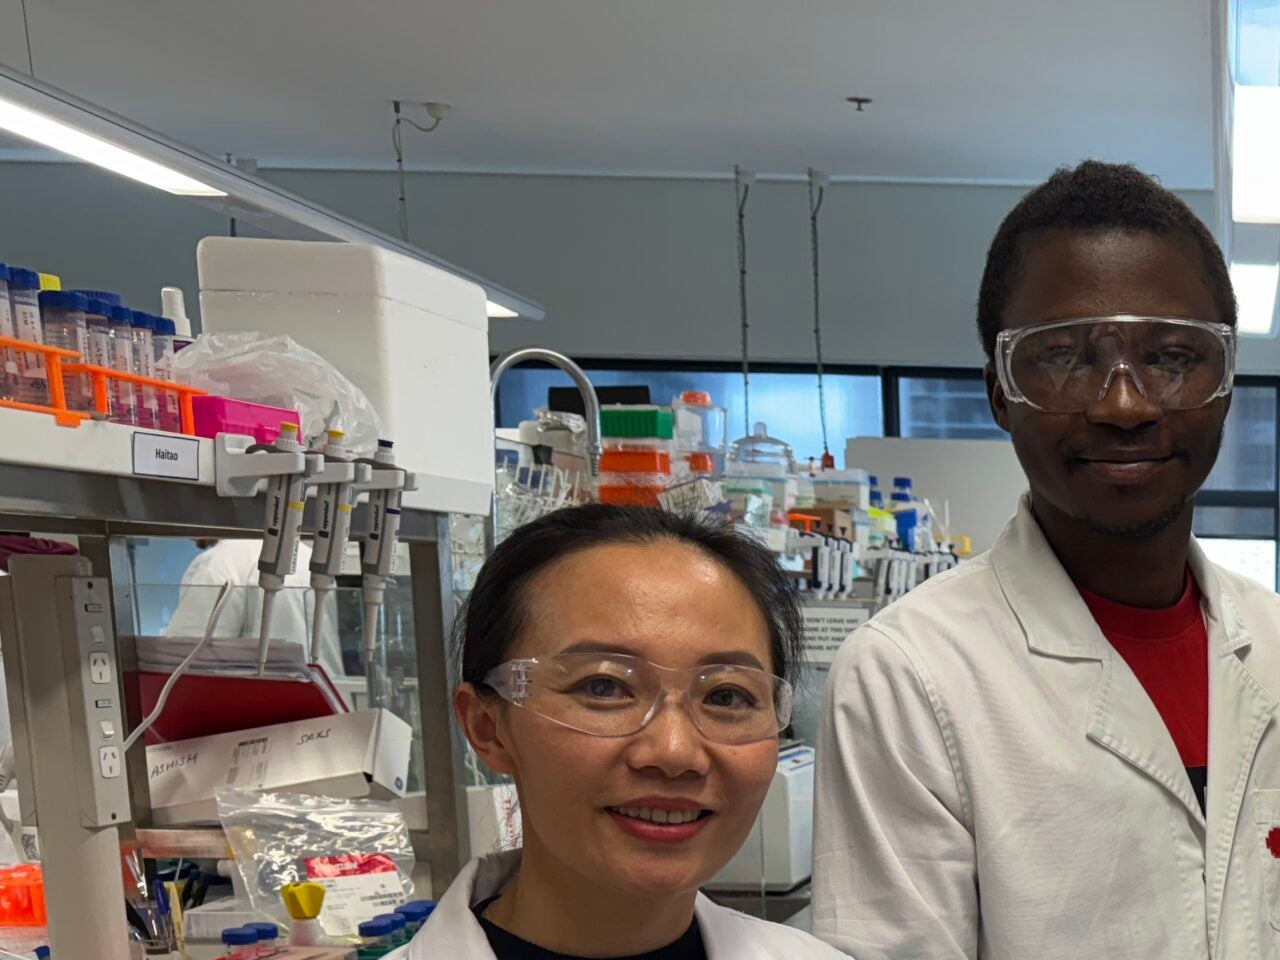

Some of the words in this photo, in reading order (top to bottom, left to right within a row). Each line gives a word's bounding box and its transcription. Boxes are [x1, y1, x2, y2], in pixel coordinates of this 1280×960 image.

[155, 447, 178, 462] Haitao
[296, 728, 332, 747] SAXS
[150, 752, 199, 779] ASHISH
